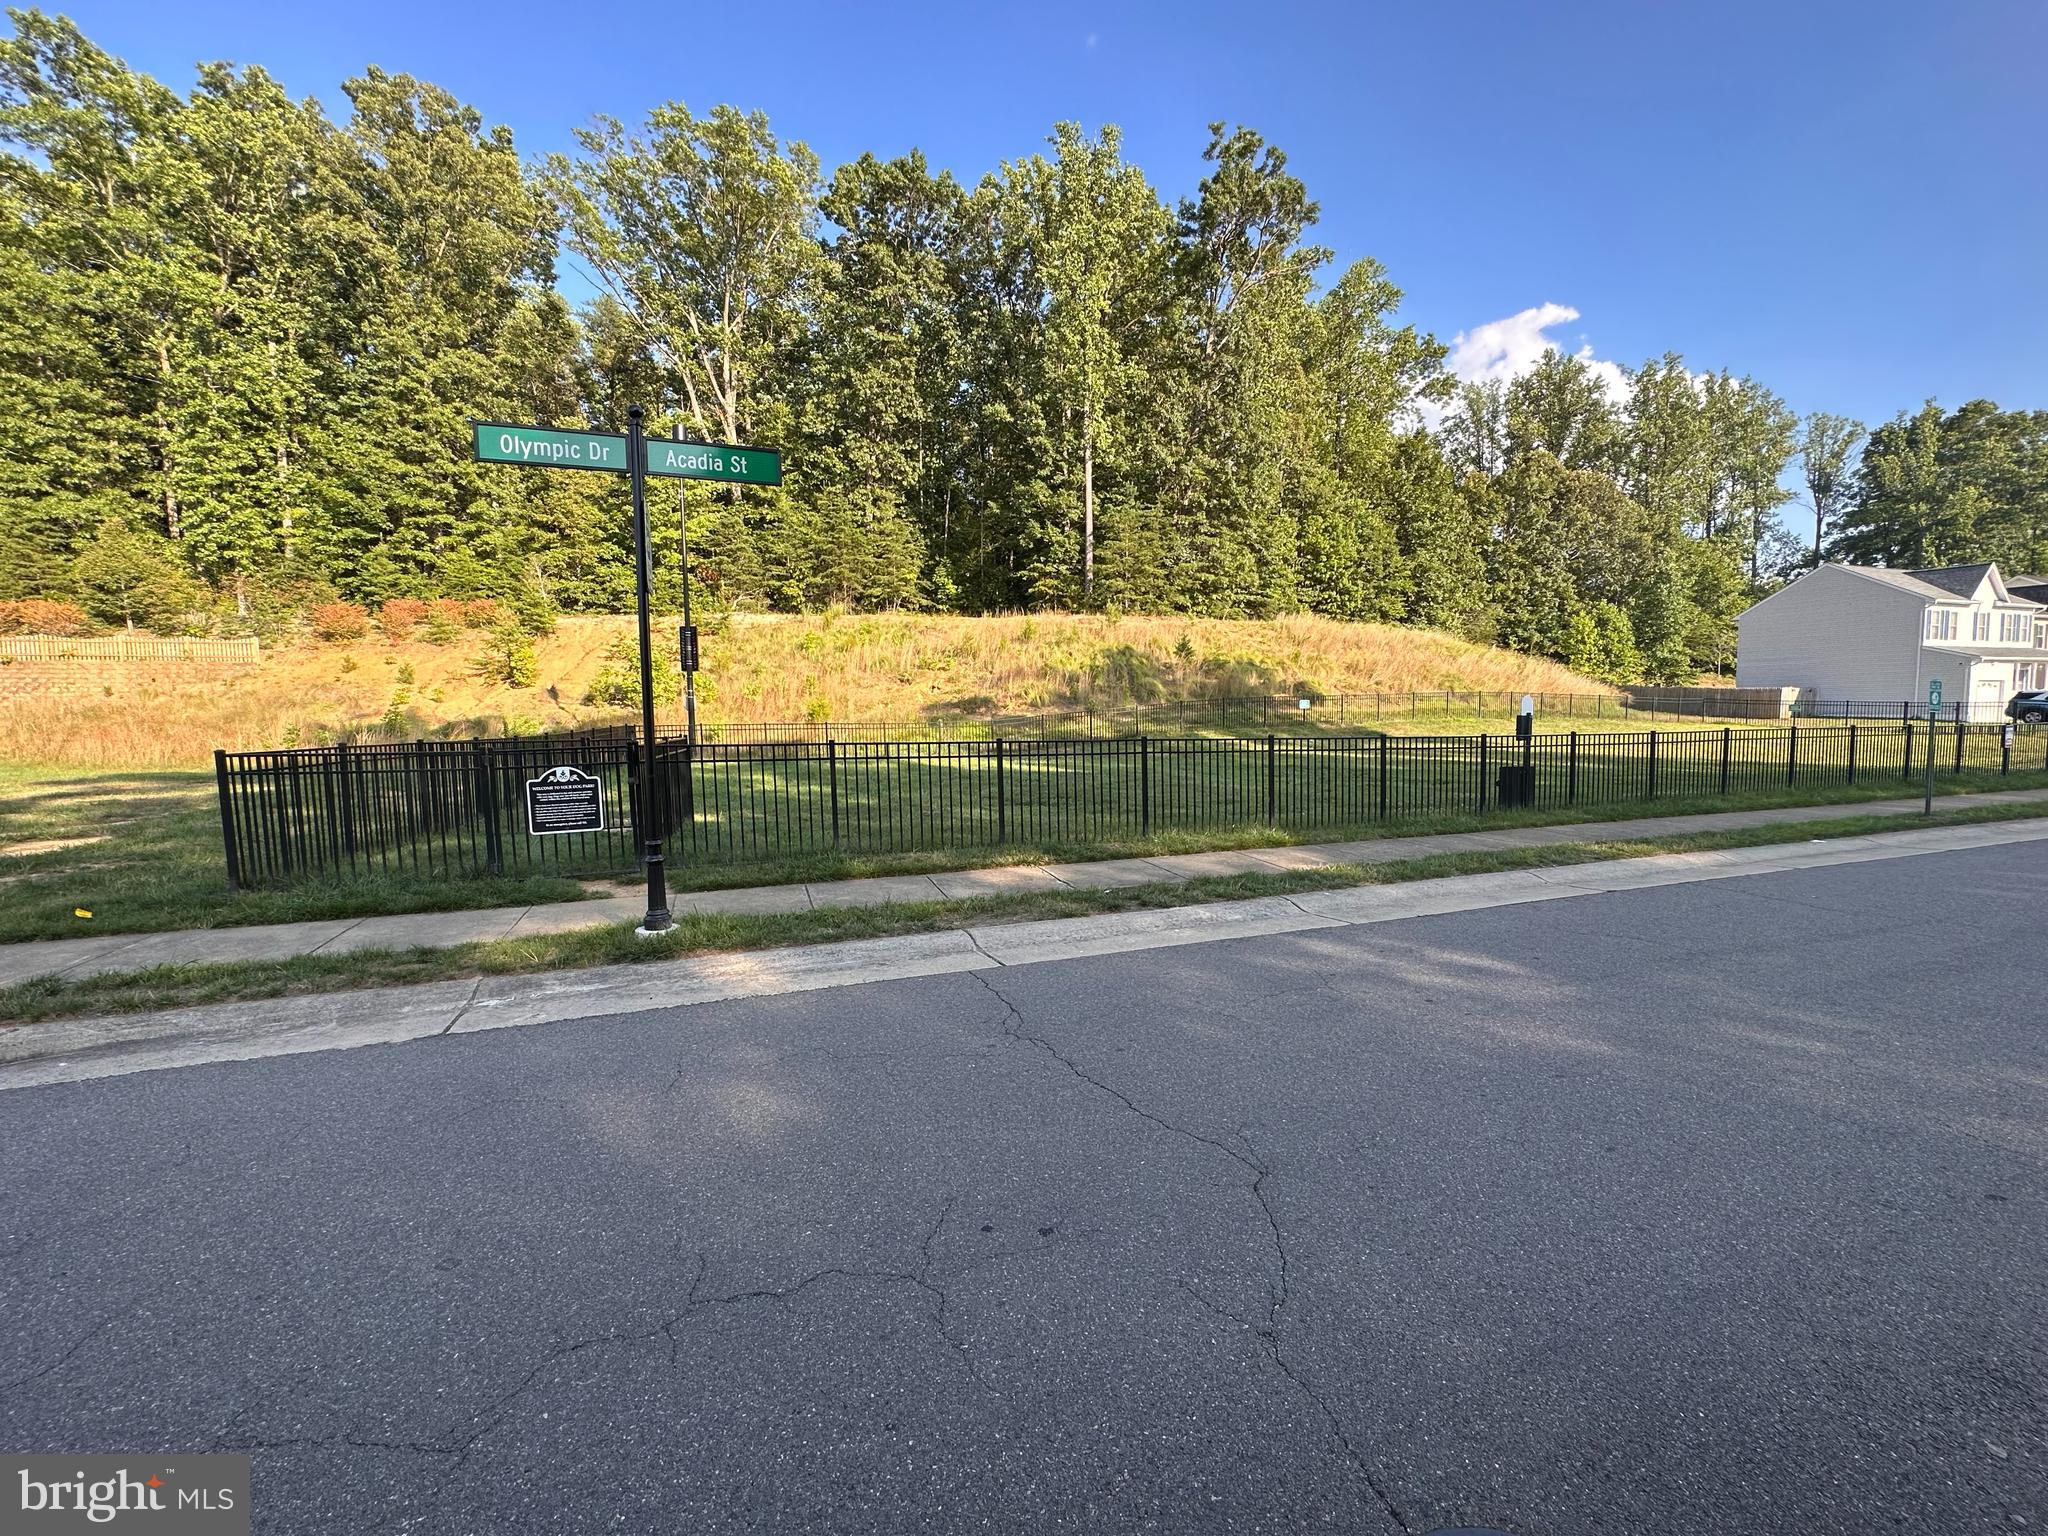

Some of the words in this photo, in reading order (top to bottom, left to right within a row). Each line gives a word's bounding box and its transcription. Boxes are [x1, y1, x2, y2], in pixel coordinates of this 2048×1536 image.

[500, 434, 581, 462] Olympic
[589, 442, 610, 461] Dr
[666, 449, 723, 472] Acadia
[730, 456, 748, 474] St
